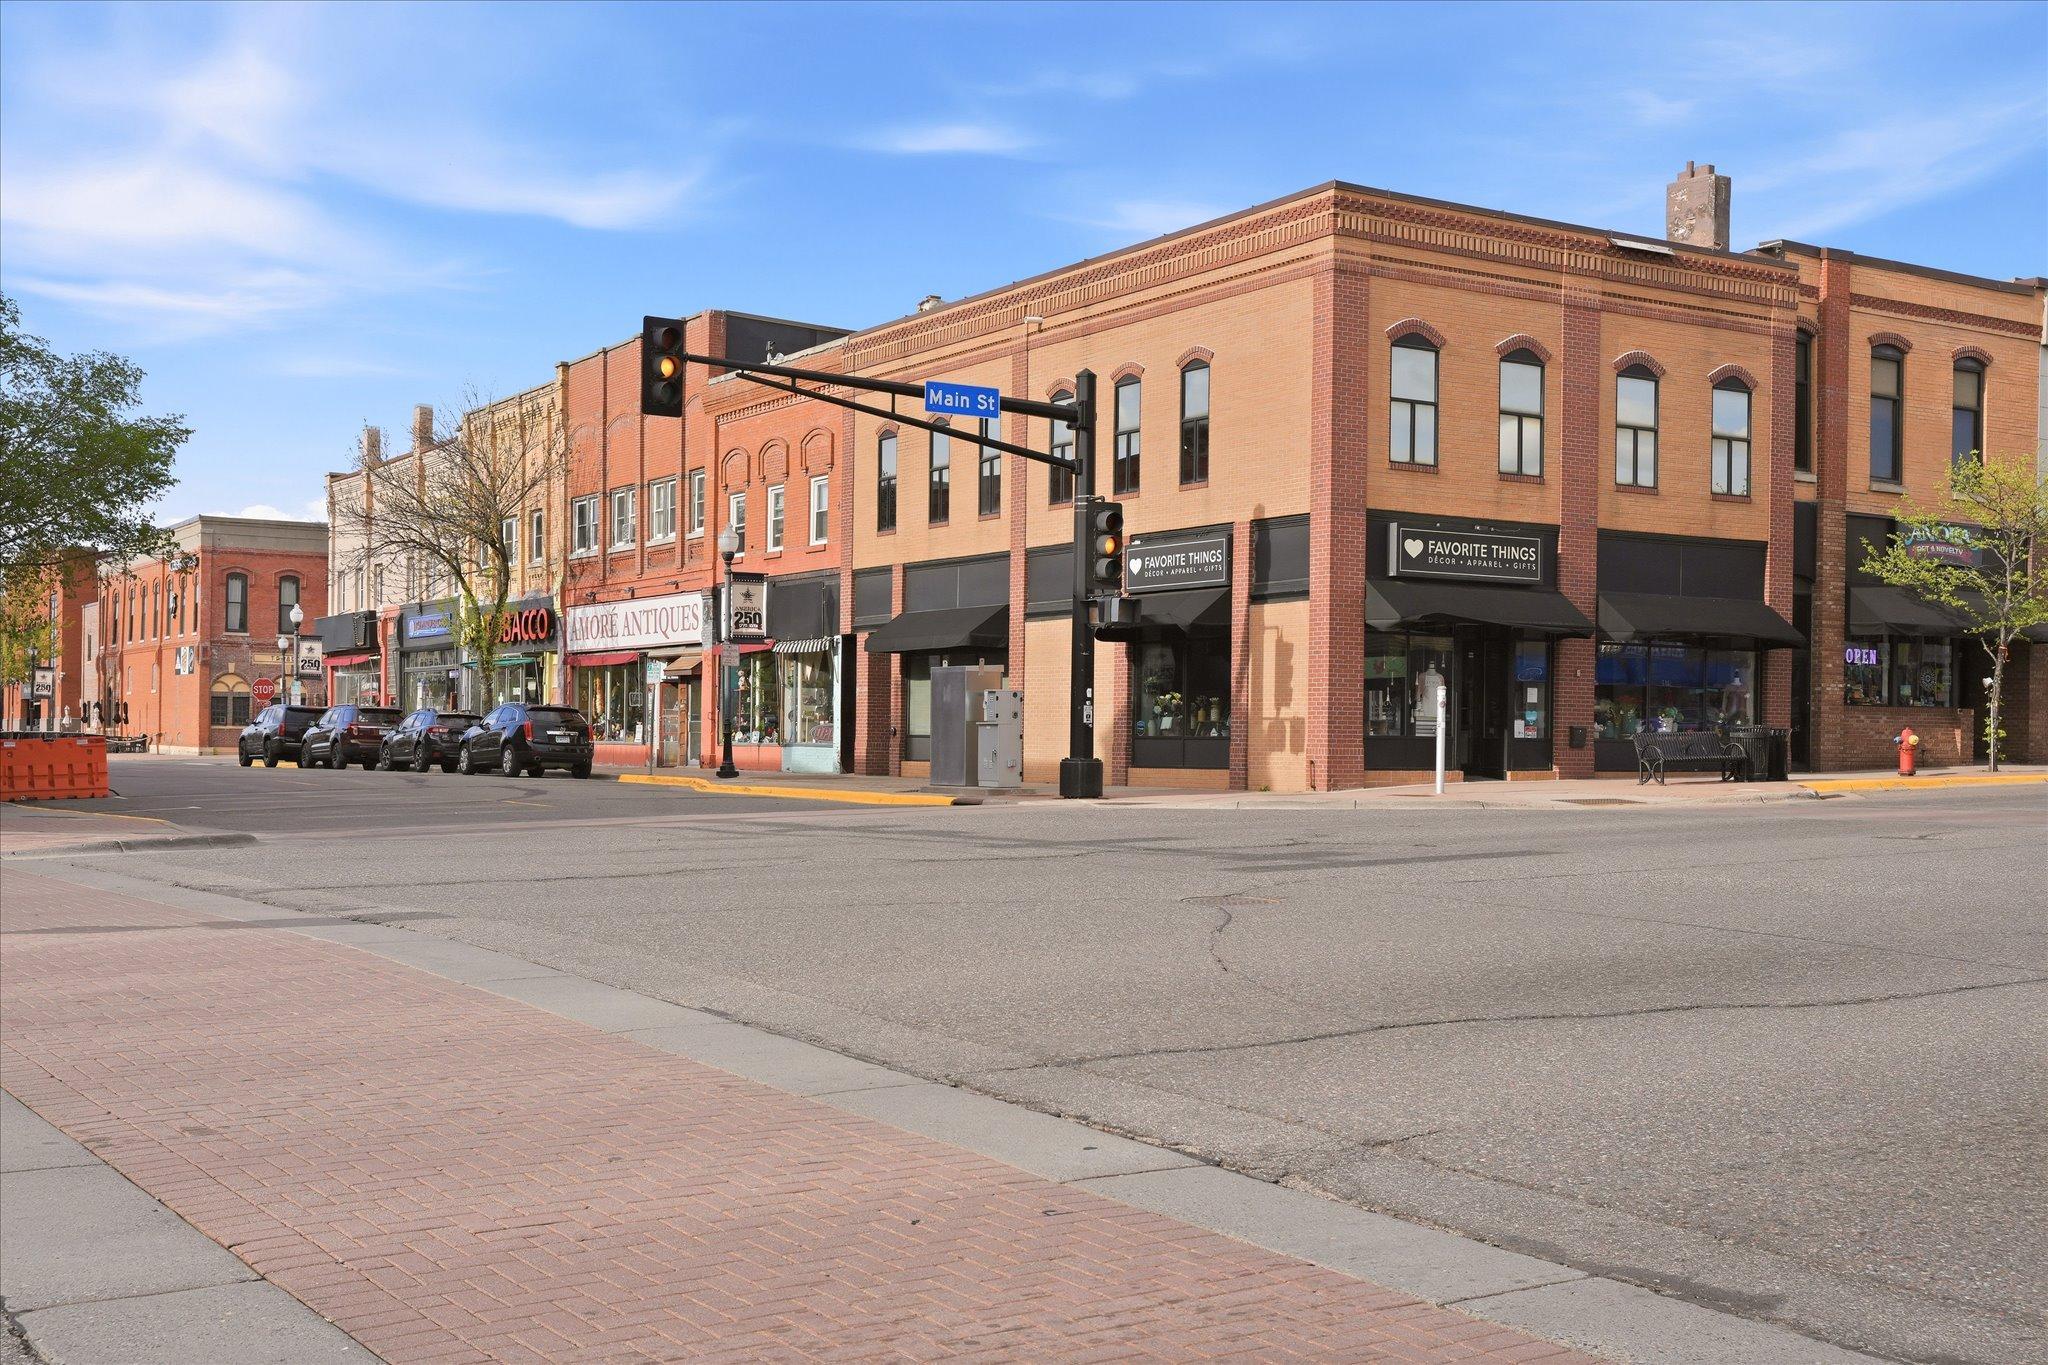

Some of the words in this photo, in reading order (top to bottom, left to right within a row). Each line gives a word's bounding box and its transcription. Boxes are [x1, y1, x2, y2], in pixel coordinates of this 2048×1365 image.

[929, 388, 970, 408] Main
[977, 394, 995, 411] St
[1144, 553, 1186, 569] FAVORITE
[1188, 549, 1222, 565] THINGS
[1428, 540, 1488, 558] FAVORITE
[1491, 545, 1536, 561] THINGS
[1936, 545, 1964, 555] NOVELTY
[1144, 569, 1164, 578] DÉCOR
[1170, 566, 1197, 575] APPAREL
[1204, 564, 1222, 572] GIFTS
[1428, 555, 1456, 565] DÉCOR
[1467, 559, 1502, 568] APPAREL
[1513, 562, 1536, 571] GIFTS
[483, 607, 548, 643] BACCO
[569, 606, 619, 641] AMORÉ
[622, 603, 699, 639] ANTIQUES
[734, 611, 762, 630] 250
[301, 659, 320, 670] 250
[1845, 648, 1877, 665] OPEN
[253, 685, 274, 694] STOP
